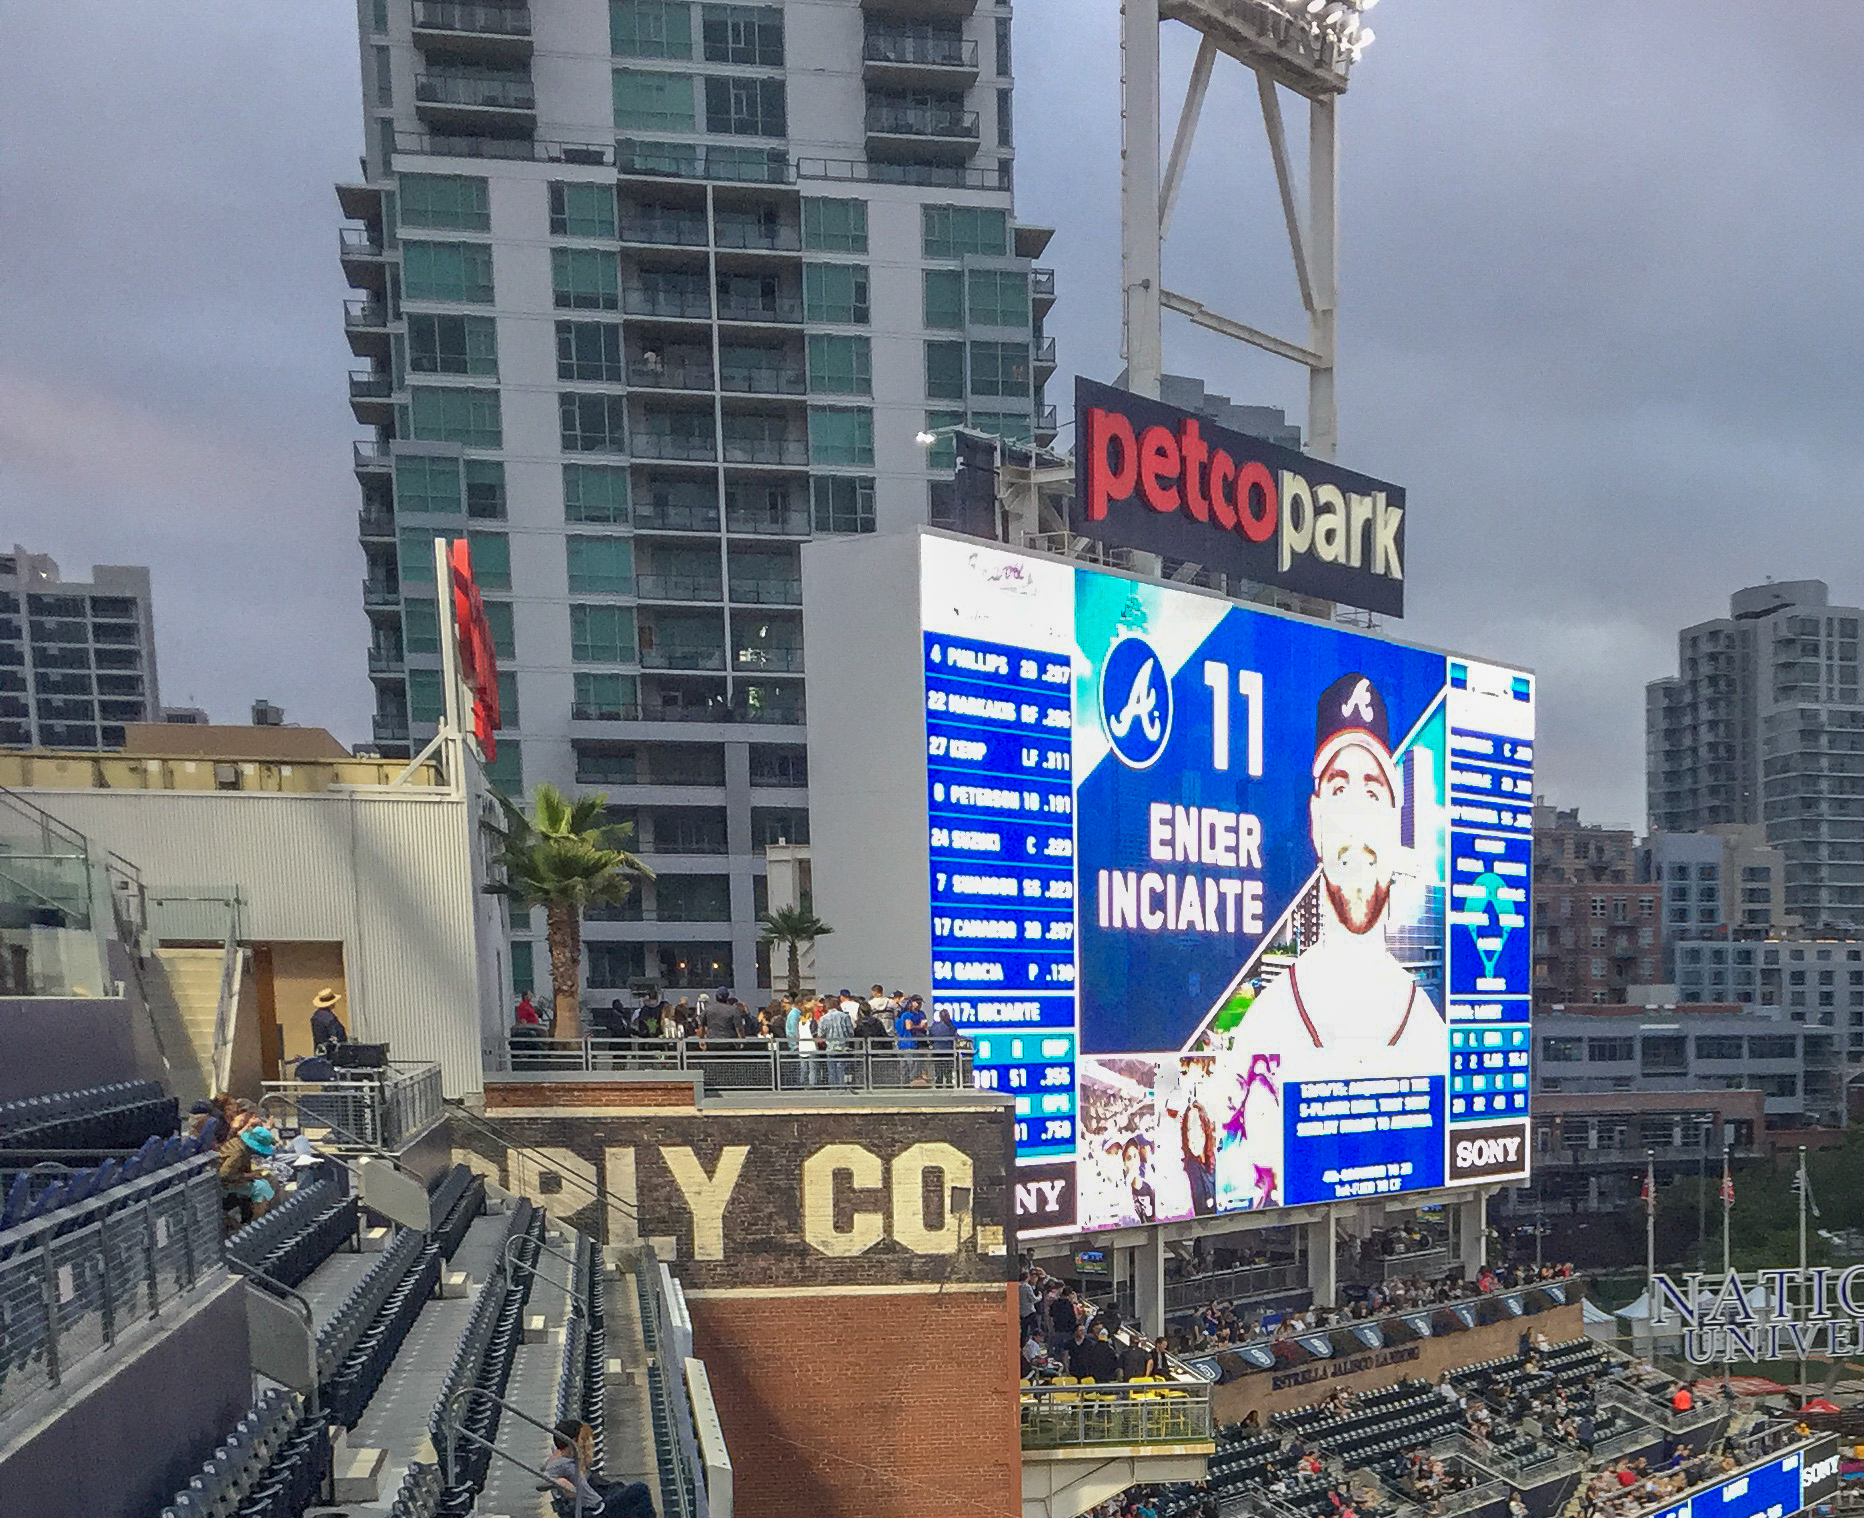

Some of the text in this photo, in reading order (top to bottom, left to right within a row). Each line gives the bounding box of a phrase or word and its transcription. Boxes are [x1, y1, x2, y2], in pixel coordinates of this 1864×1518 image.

[1204, 660, 1263, 777] 11
[1150, 802, 1263, 869] ENDER
[936, 873, 946, 891] 7
[1098, 870, 1264, 934] INCIARTE
[1028, 963, 1039, 981] P
[1456, 1137, 1521, 1168] SONY
[804, 1141, 1006, 1258] CO.
[1272, 1366, 1328, 1391] ESTRELLA
[1803, 1454, 1840, 1487] SONY
